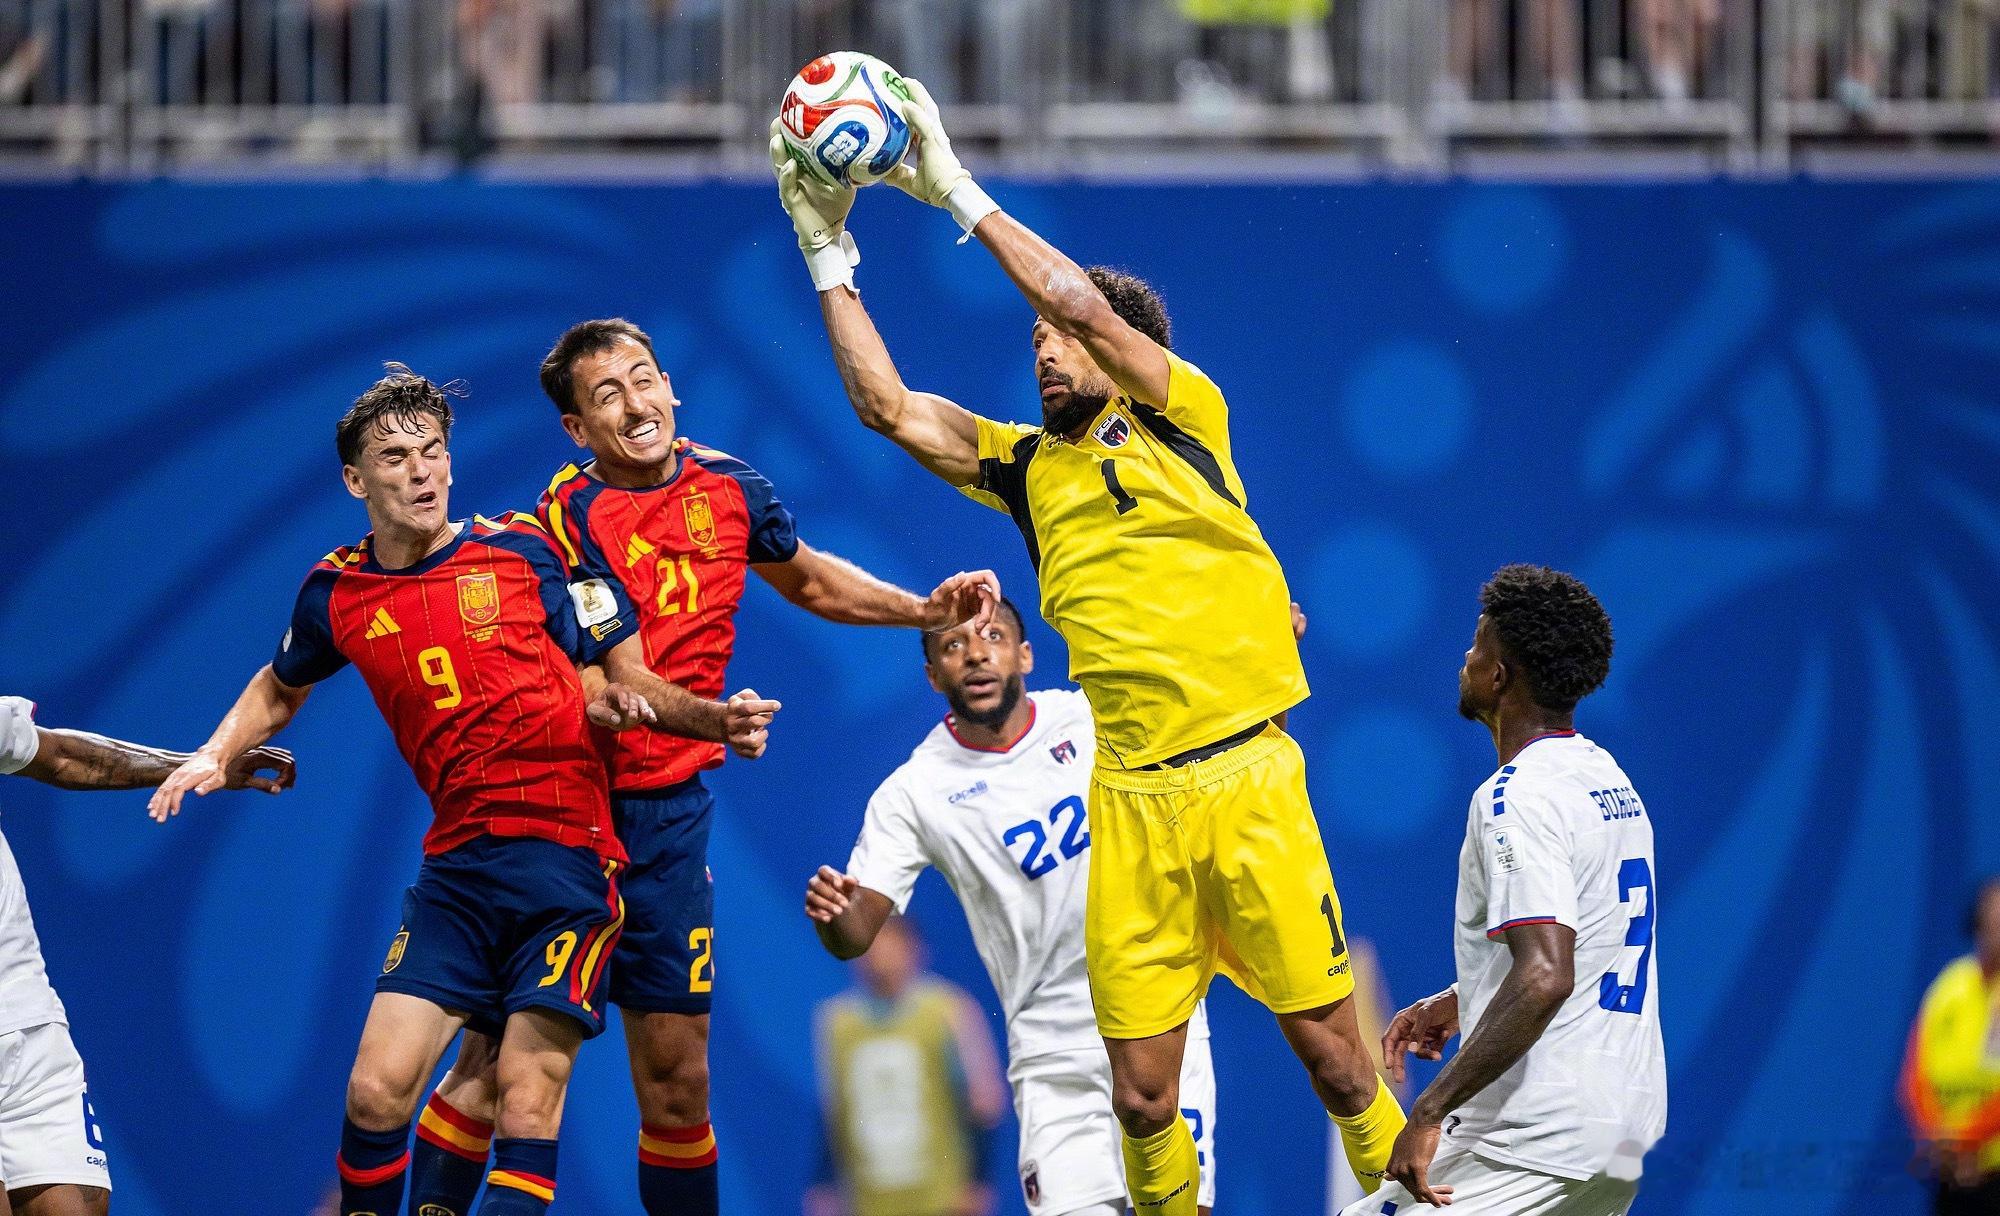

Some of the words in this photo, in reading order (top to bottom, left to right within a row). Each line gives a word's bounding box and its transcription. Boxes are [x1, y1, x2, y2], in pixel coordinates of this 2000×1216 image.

[1101, 458, 1139, 517] 1
[656, 554, 699, 617] 21
[417, 646, 462, 711] 9
[947, 780, 989, 804] capelli
[1002, 794, 1092, 881] 22
[1320, 892, 1346, 958] 1
[1598, 857, 1656, 1015] 3
[537, 930, 578, 988] 9
[688, 927, 715, 993] 2
